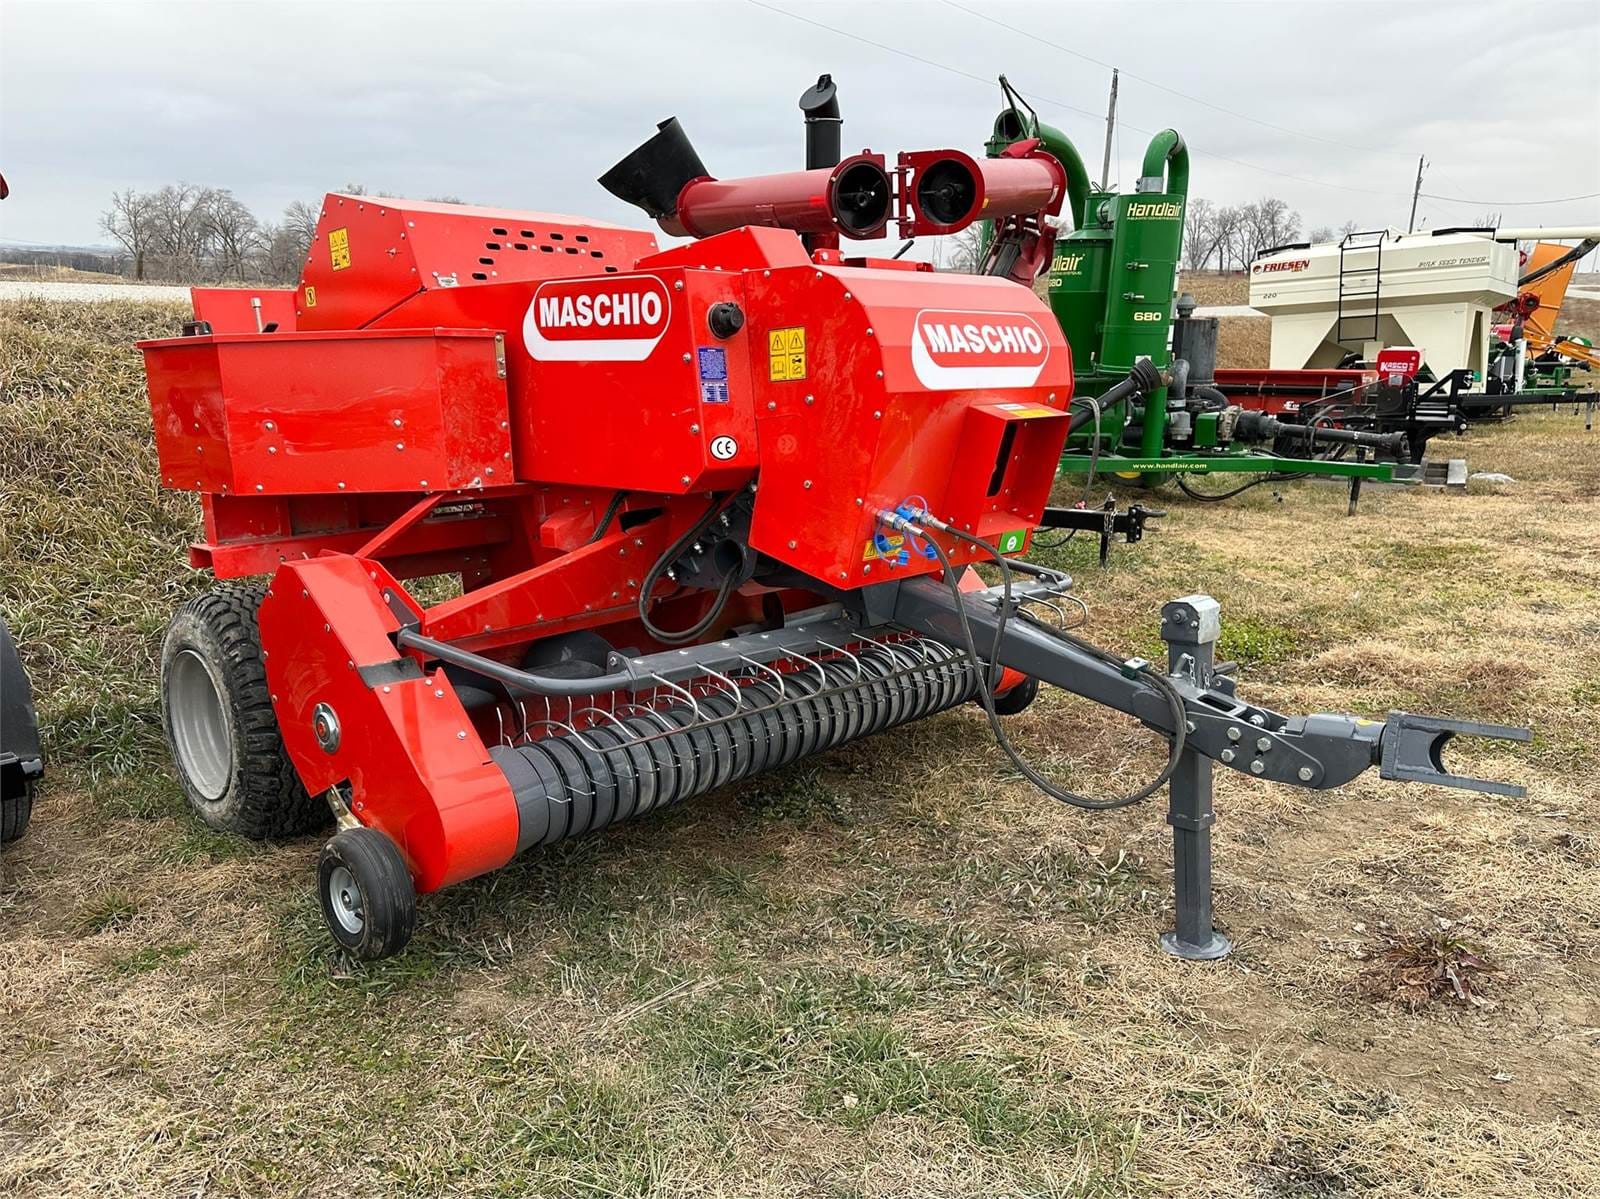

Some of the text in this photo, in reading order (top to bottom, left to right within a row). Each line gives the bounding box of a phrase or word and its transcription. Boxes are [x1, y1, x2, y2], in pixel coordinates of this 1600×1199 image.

[1127, 202, 1181, 217] Handlair
[1052, 253, 1083, 272] dlair
[1263, 259, 1310, 273] FRIESEN
[1439, 258, 1457, 266] SEED
[1459, 256, 1486, 264] TENDER
[538, 290, 663, 328] MASCHIO
[1133, 312, 1162, 321] 680
[923, 323, 1042, 355] MASCHIO
[1380, 361, 1409, 372] KASCO
